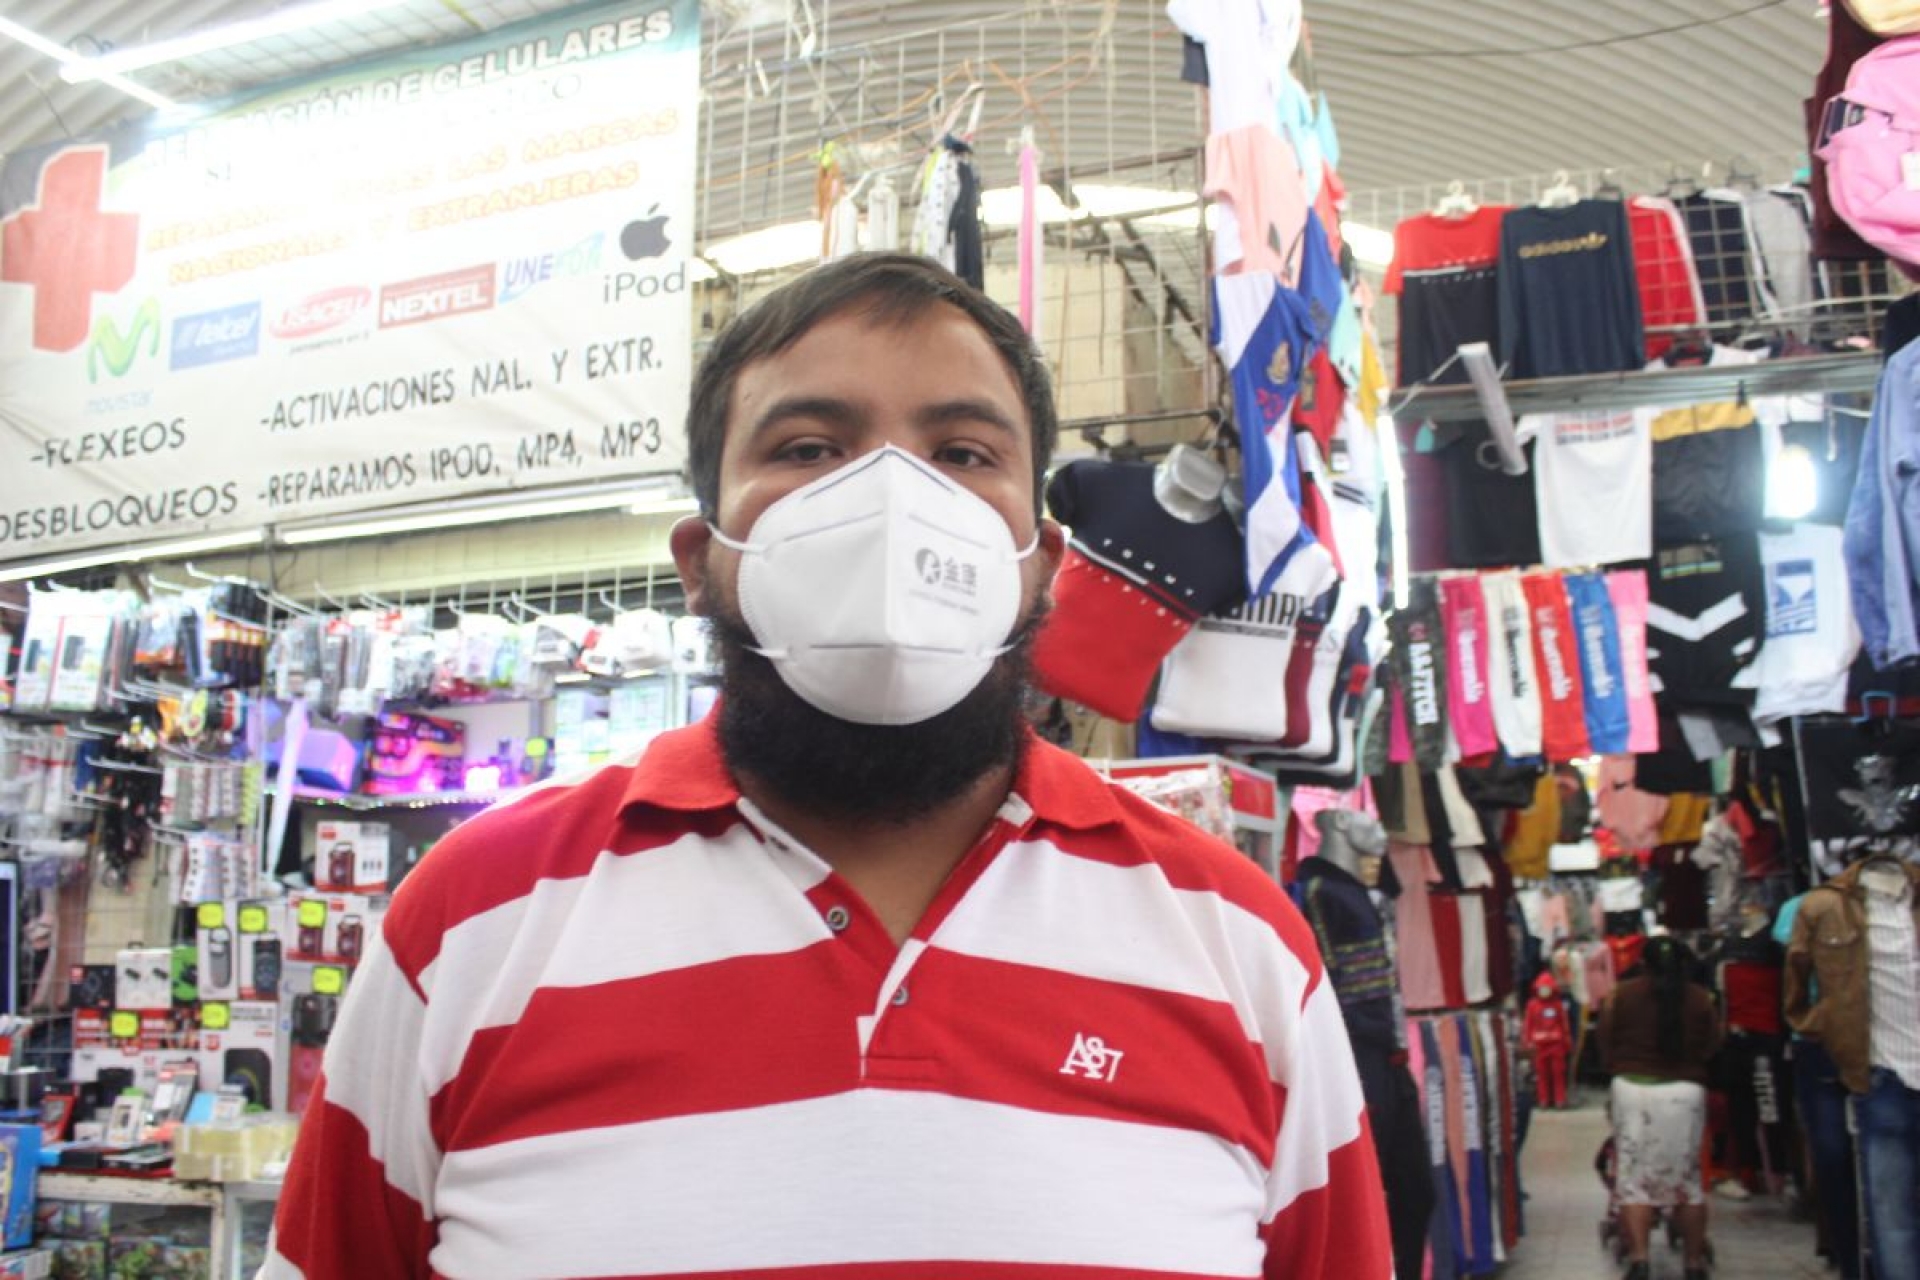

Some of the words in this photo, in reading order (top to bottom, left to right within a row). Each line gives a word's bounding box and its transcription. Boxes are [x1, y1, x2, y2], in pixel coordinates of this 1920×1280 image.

[372, 69, 423, 110] DE
[432, 10, 672, 93] CELULARES
[146, 196, 305, 253] REPARAM
[447, 143, 509, 182] LAS
[522, 106, 680, 164] MARCAS
[408, 160, 640, 232] EXTRANJERAS
[383, 280, 488, 321] NEXTEL
[603, 261, 686, 304] iPod
[260, 368, 455, 432] -ACTIVACIONES
[472, 359, 533, 397] NAL.
[552, 349, 568, 383] Y
[587, 336, 663, 380] EXTR.
[259, 453, 417, 507] -REPARAMOS
[517, 430, 583, 469] MP4,
[601, 418, 662, 459] MP3
[0, 482, 238, 542] DESBLOQUEOS
